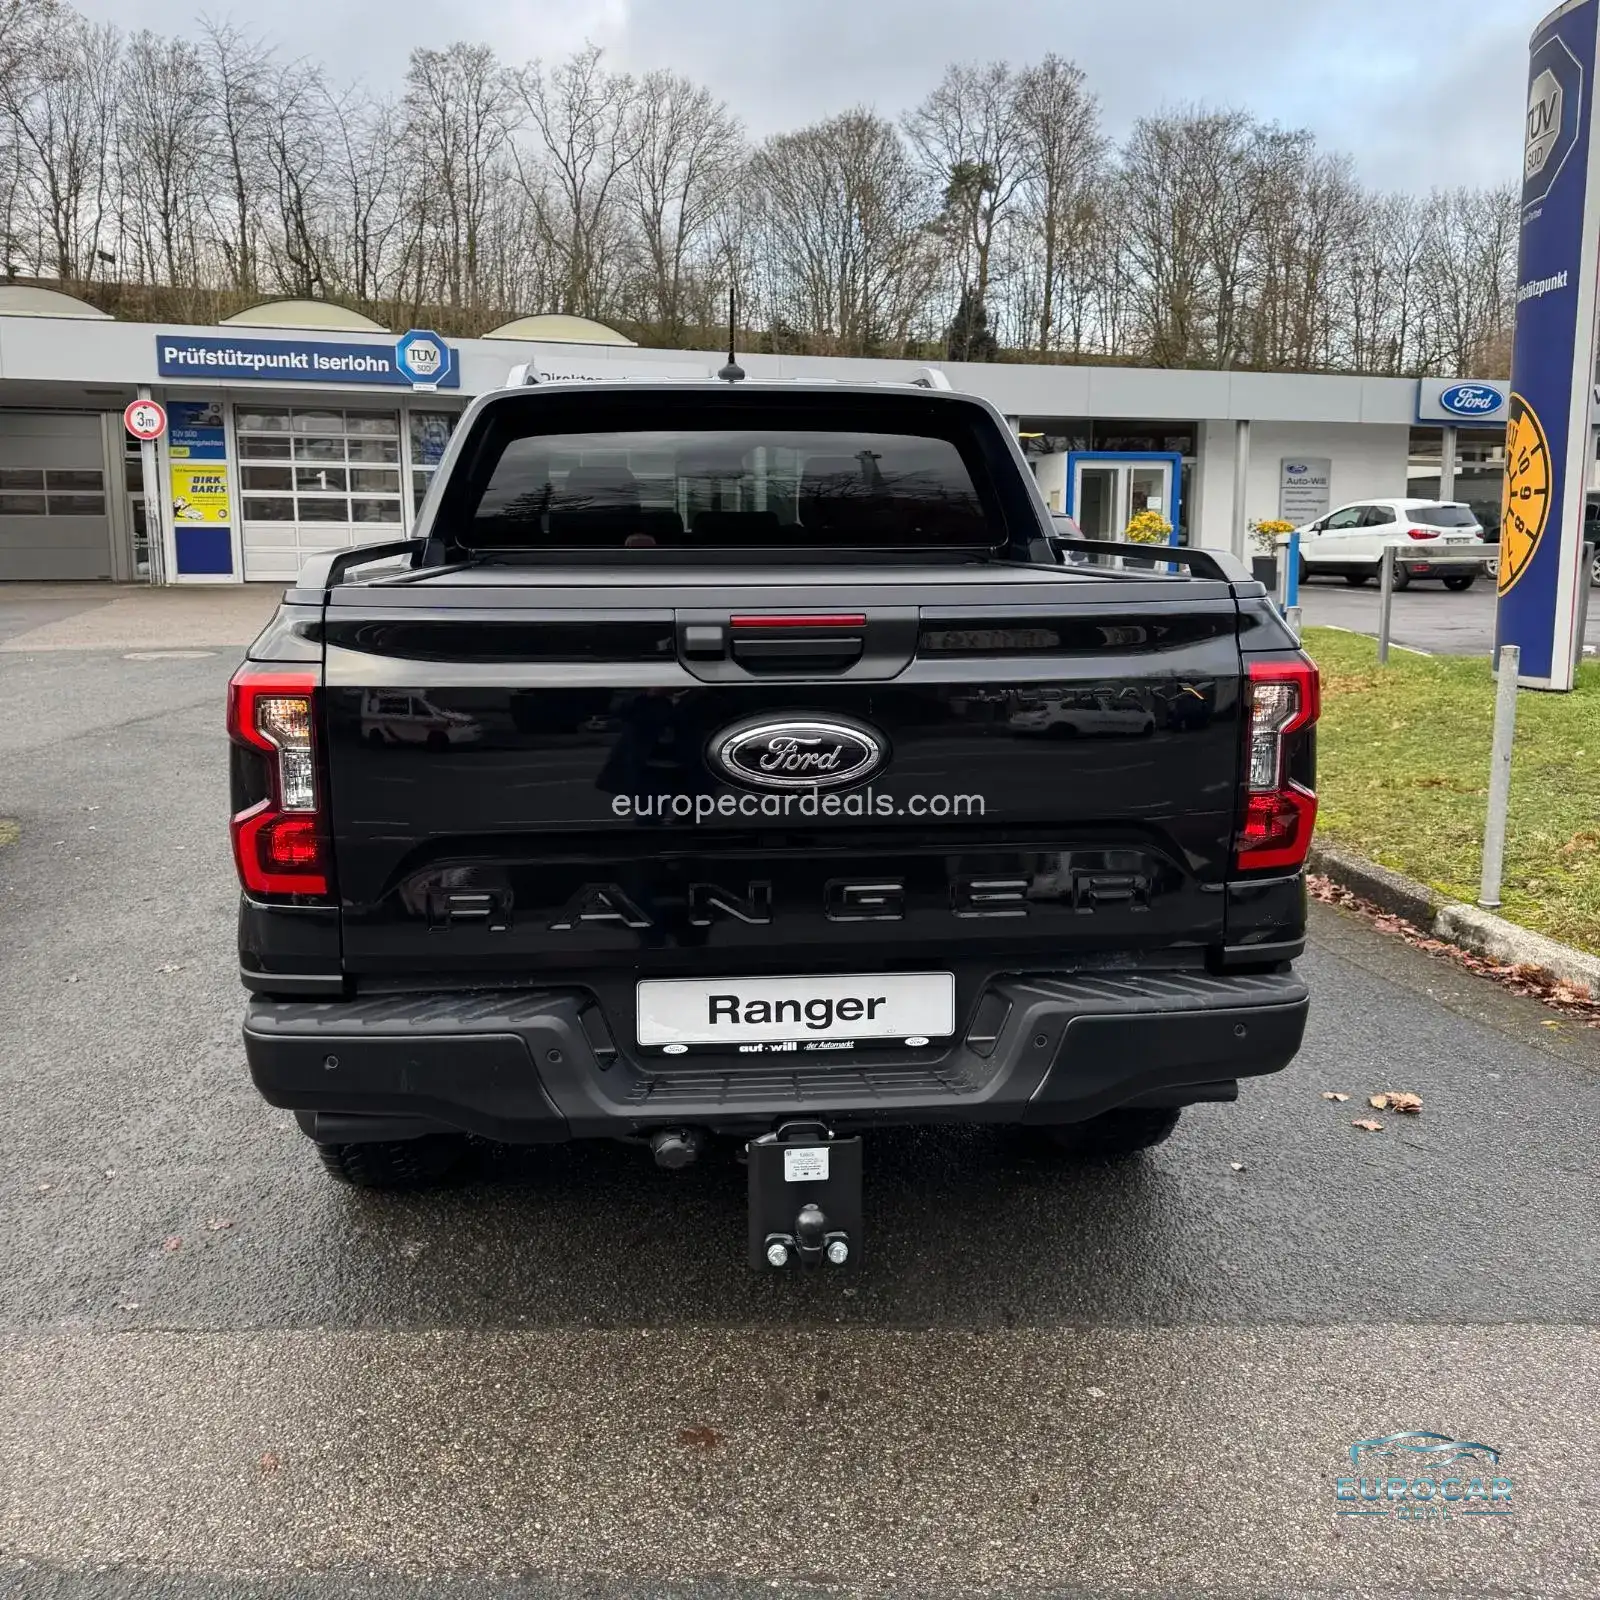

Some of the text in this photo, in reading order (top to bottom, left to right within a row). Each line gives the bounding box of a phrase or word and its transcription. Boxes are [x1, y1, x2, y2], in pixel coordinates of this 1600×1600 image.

[1527, 89, 1557, 139] TÜV
[1527, 146, 1543, 171] SÜD
[164, 347, 390, 372] Prüfstützpunkt Iserlohn
[409, 348, 437, 362] TÜV
[417, 364, 432, 372] SÜD
[1453, 388, 1493, 409] Ford
[193, 476, 221, 484] DIRK
[316, 470, 327, 490] 1
[1286, 477, 1327, 485] Auto-Will
[760, 736, 844, 771] Ford
[427, 868, 1152, 934] RANGER
[708, 995, 887, 1030] Ranger
